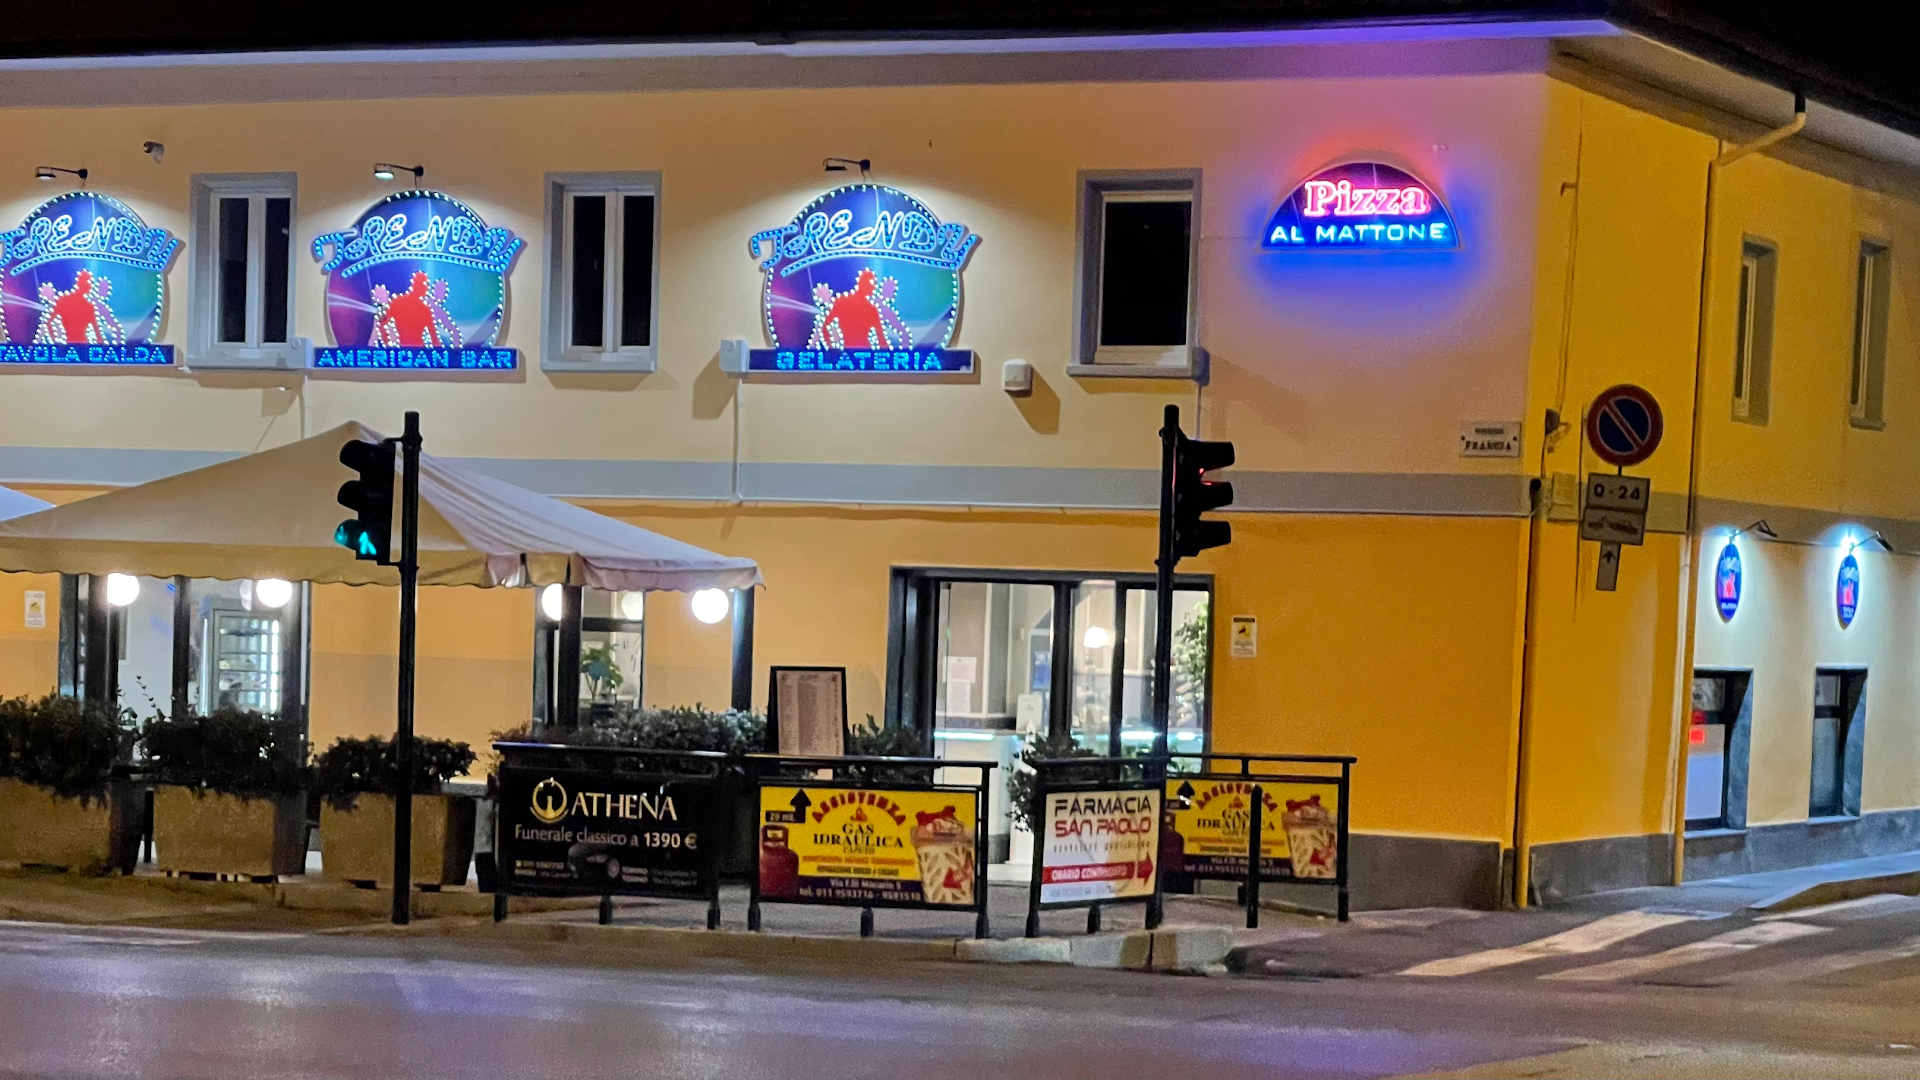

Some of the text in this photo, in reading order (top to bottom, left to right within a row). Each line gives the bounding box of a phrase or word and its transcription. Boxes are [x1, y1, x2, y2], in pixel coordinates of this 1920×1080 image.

[1304, 180, 1431, 217] Pizza
[751, 209, 978, 270] TRENDY
[1271, 222, 1448, 243] AL MATTONE
[313, 214, 522, 273] TRENDY
[88, 346, 167, 363] CALDA
[318, 350, 511, 368] AMERICAN BAR
[776, 351, 942, 370] GELATERIA
[571, 792, 677, 821] ATHENA
[1055, 795, 1152, 816] FARMACIA
[515, 824, 698, 849] Funerale classico a 1390 €
[843, 823, 874, 834] GAS
[1097, 816, 1152, 836] PAOLO
[813, 833, 904, 848] IDRAULICA
